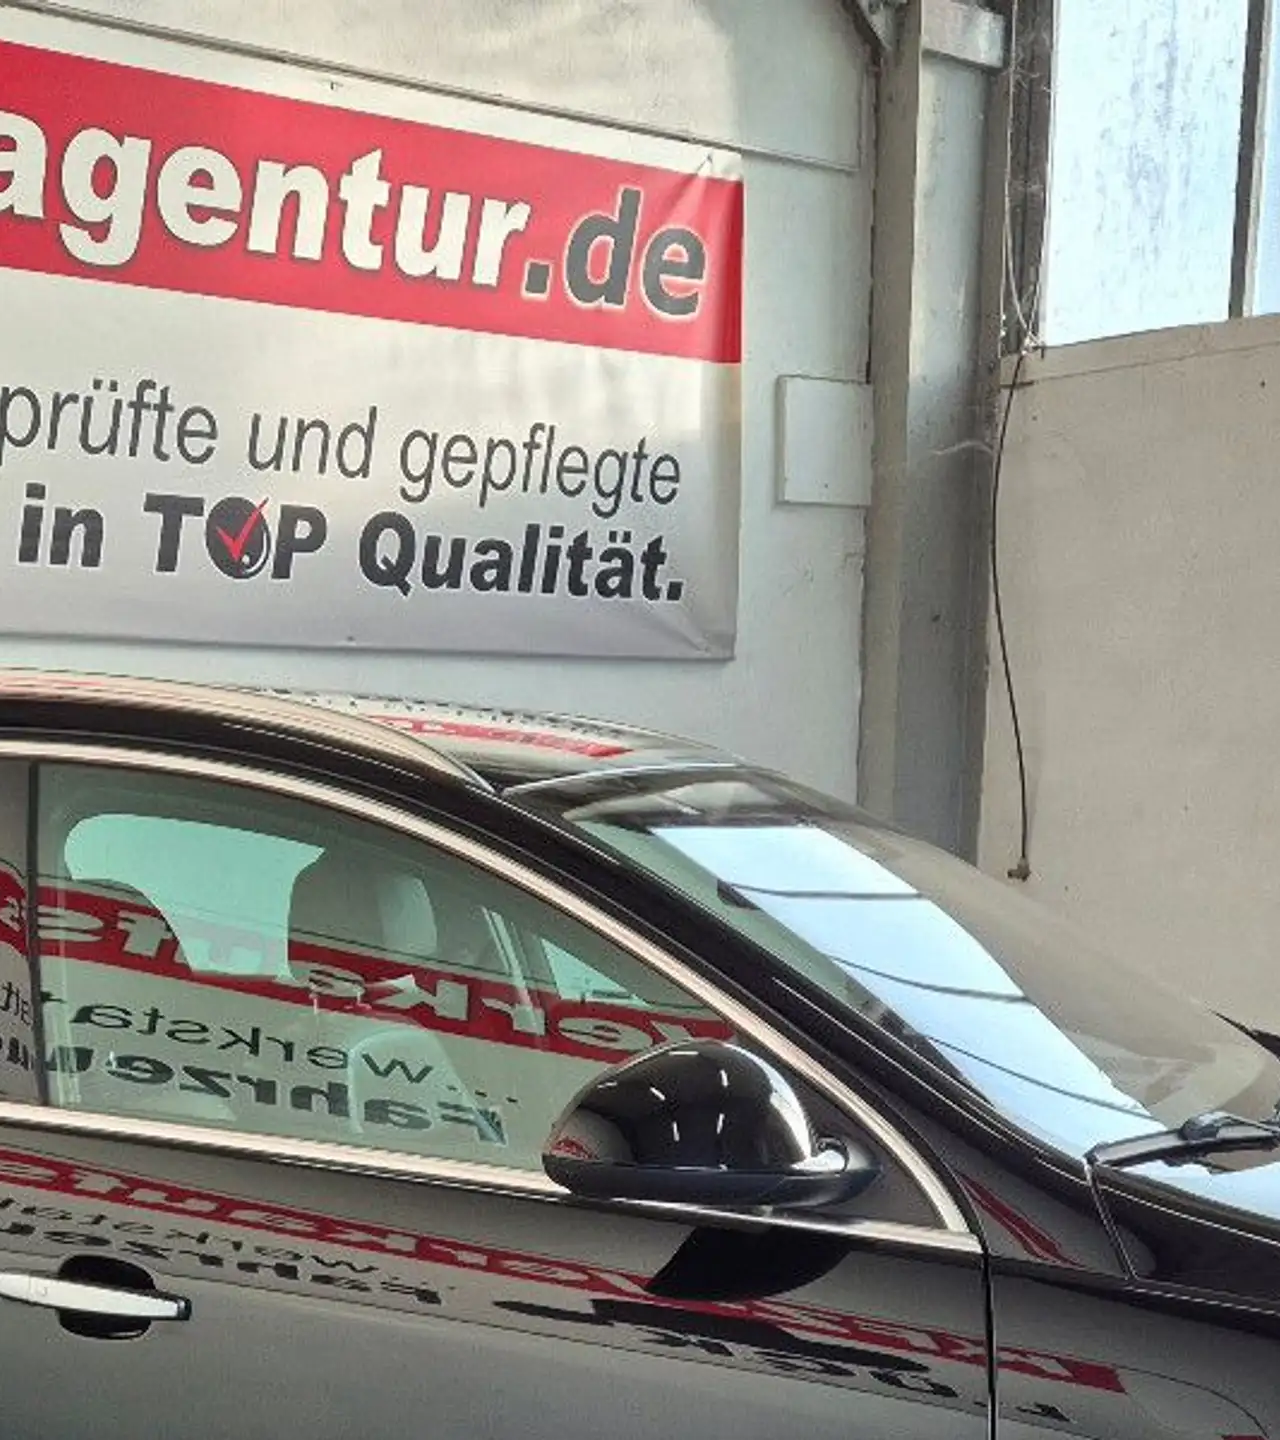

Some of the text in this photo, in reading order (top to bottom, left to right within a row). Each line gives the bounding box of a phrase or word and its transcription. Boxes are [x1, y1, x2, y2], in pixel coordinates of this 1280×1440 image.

[247, 405, 378, 479] und
[399, 422, 681, 519] gepflegte
[19, 482, 104, 567] in
[143, 492, 328, 579] TOP
[359, 511, 683, 601] Qualität.
